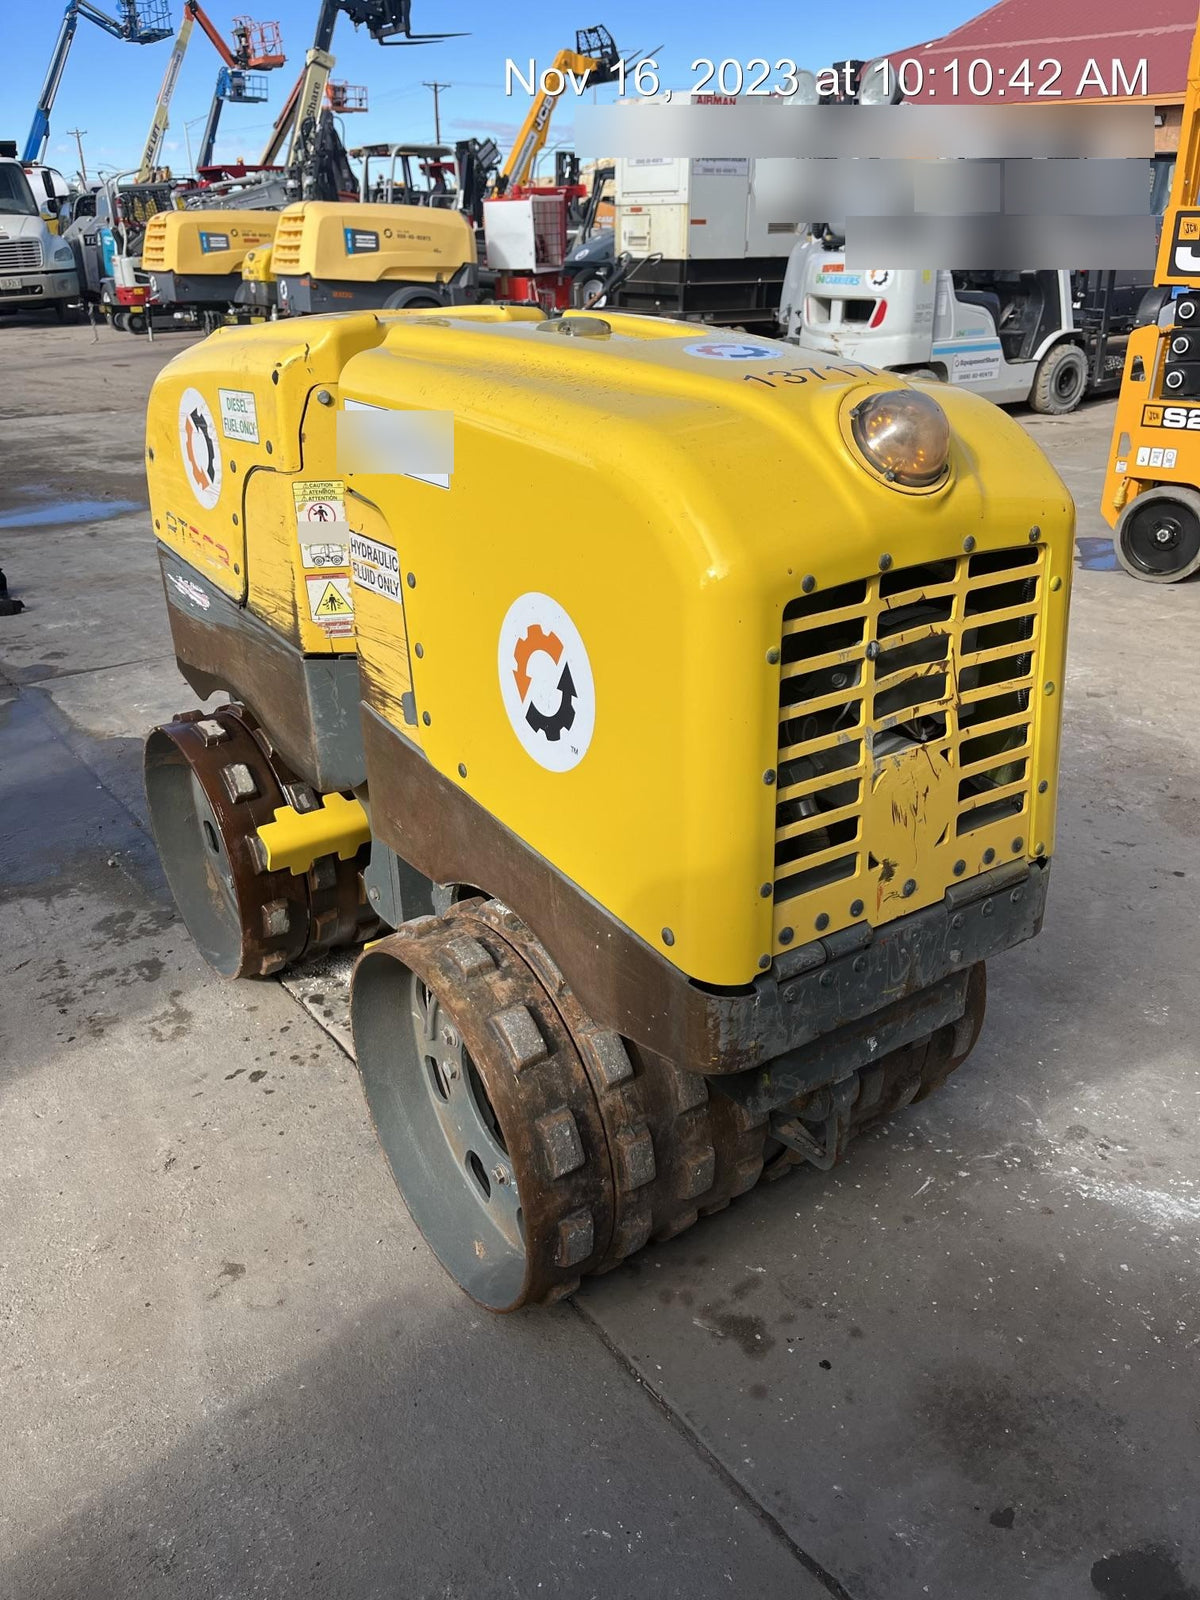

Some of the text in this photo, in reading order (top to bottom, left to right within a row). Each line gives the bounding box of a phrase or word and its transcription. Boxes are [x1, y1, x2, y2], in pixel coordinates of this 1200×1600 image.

[743, 364, 878, 388] 13717
[226, 397, 249, 413] DIESEL
[223, 416, 257, 436] FUEL ONLY
[350, 537, 399, 573] HYDRAULIC
[352, 561, 400, 597] FLUID ONLY
